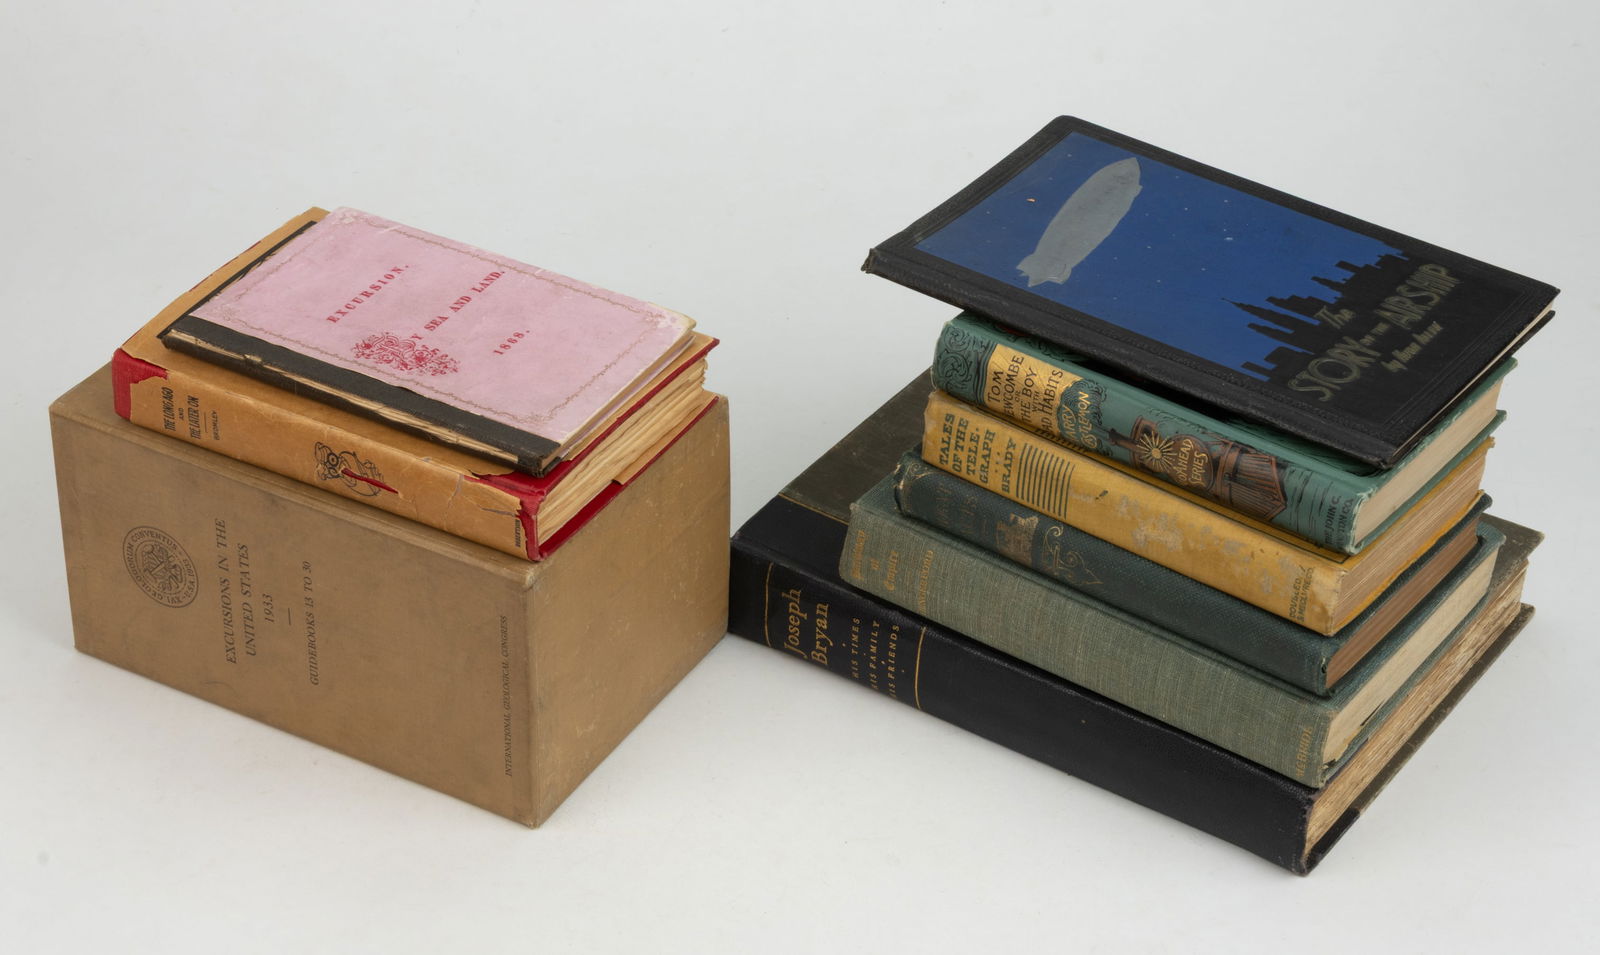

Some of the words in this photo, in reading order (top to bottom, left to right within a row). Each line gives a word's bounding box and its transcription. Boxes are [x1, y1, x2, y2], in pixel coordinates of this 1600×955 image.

[326, 265, 410, 324] EXCURSION.
[424, 315, 449, 332] SEA
[449, 295, 473, 313] AND
[471, 271, 505, 294] LAND.
[1287, 335, 1382, 402] STORY
[1374, 263, 1461, 330] AIRSHIP
[1314, 305, 1356, 330] The
[161, 386, 174, 401] AGO
[987, 370, 1004, 403] TOM
[1003, 355, 1025, 418] EWCOMBE
[1014, 391, 1021, 402] OR
[1022, 367, 1037, 398] BOY
[1039, 369, 1064, 416] HABITS
[163, 400, 175, 420] LONG
[187, 394, 199, 408] ON
[187, 407, 200, 428] LATER
[1018, 401, 1032, 422] THE
[1031, 390, 1040, 413] WITH
[164, 418, 176, 431] THE
[189, 427, 201, 440] THE
[940, 413, 955, 465] TALES
[955, 418, 969, 452] THE
[1041, 417, 1054, 432] AD
[1062, 405, 1077, 439] ARRY
[951, 453, 962, 473] OF
[979, 429, 996, 484] GRAPH
[1001, 437, 1017, 494] BRADY
[1188, 450, 1209, 487] SERIES
[1325, 506, 1337, 532] JOHN
[1331, 495, 1342, 505] C.
[215, 518, 227, 549] THE
[218, 555, 229, 572] IN
[237, 543, 252, 598] STATES
[302, 561, 312, 573] 30
[303, 576, 313, 593] TO
[262, 593, 275, 623] 1933
[304, 597, 314, 608] 13
[219, 577, 237, 664] EXCURSIONS
[242, 602, 257, 656] UNITED
[500, 615, 509, 658] CONGRESS
[782, 588, 808, 660] Joseph
[810, 603, 835, 666] Bryan
[852, 617, 862, 656] TIMES
[305, 612, 319, 685] GUIDEBOOKS
[869, 620, 880, 669] FAMILY
[887, 625, 900, 680] FRIENDS
[502, 661, 511, 712] GEOLOGICAL
[852, 660, 860, 679] HIS
[504, 713, 513, 777] INTERNATIONAL
